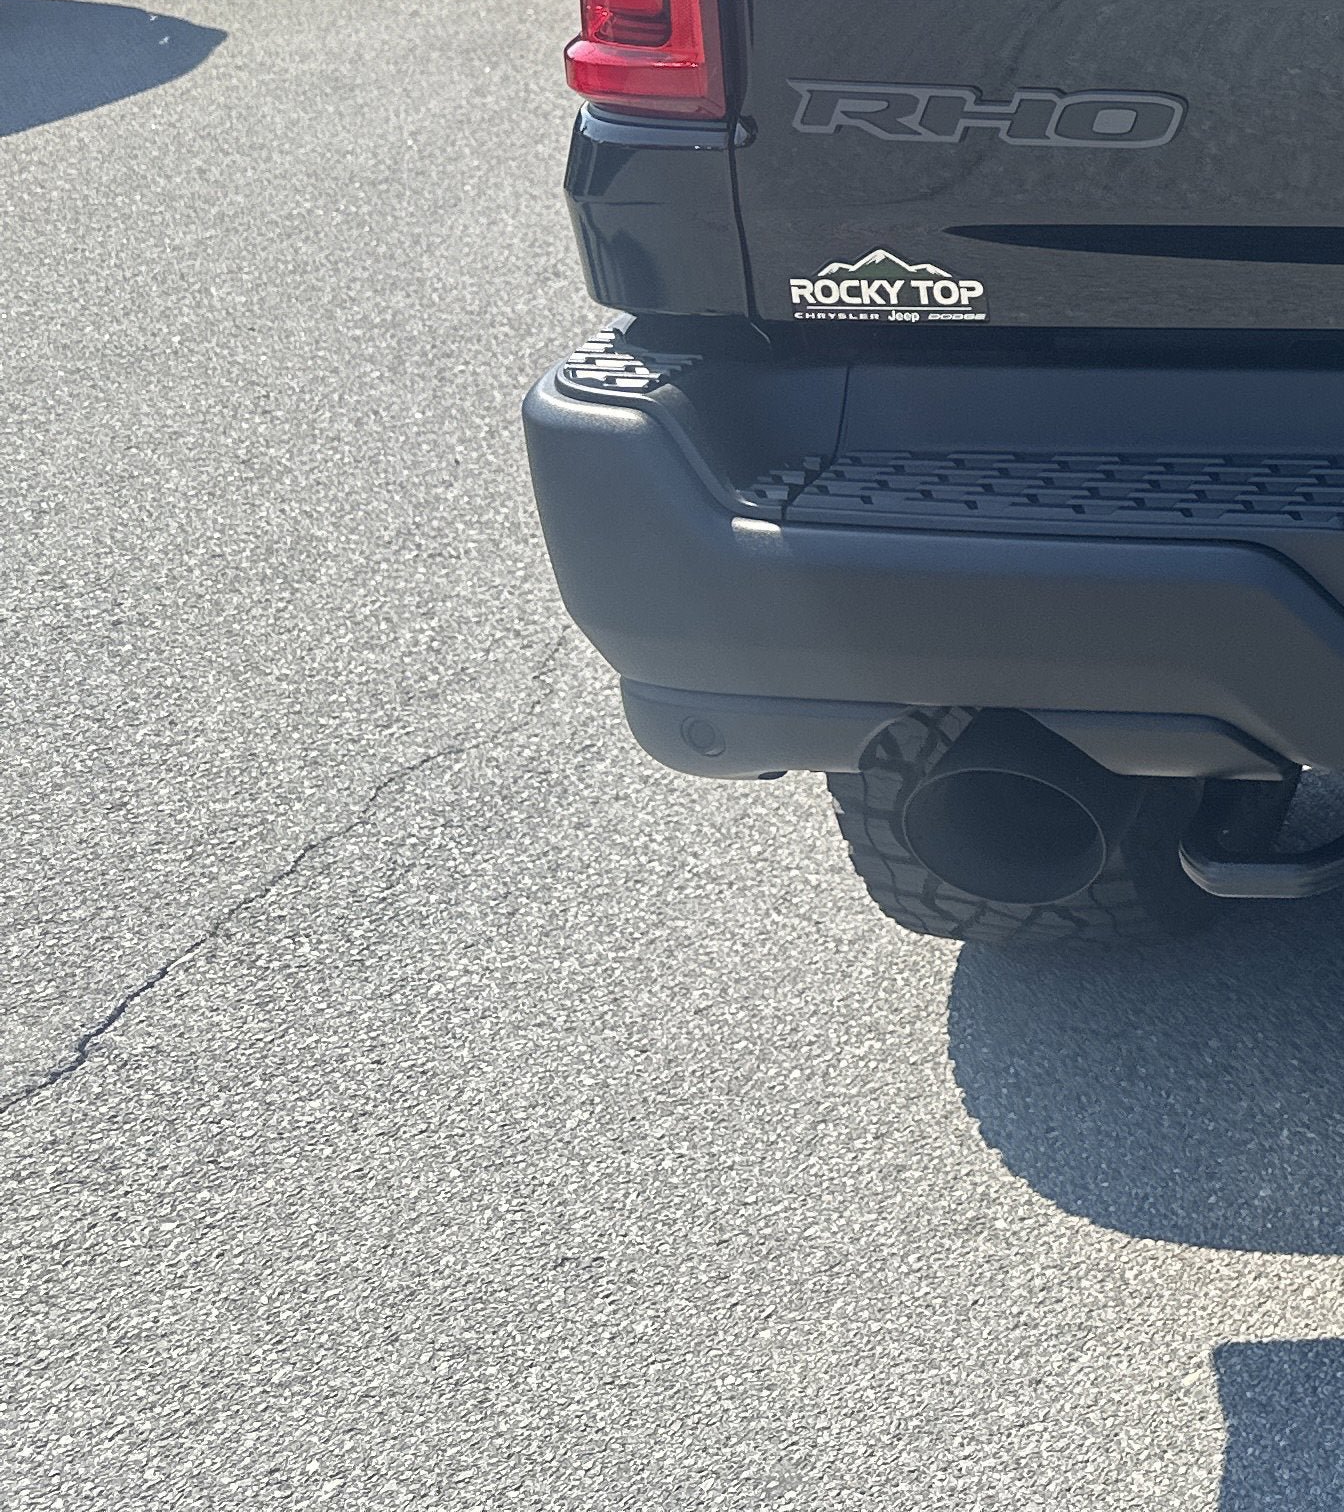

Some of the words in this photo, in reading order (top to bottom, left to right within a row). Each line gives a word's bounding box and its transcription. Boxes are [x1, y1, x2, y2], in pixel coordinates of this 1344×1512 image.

[788, 79, 1189, 148] RHO
[789, 278, 905, 305] ROCKY
[910, 280, 984, 306] TOP
[794, 311, 880, 321] CHRYSLER
[887, 310, 920, 323] Jeep
[927, 313, 987, 321] DODGE
